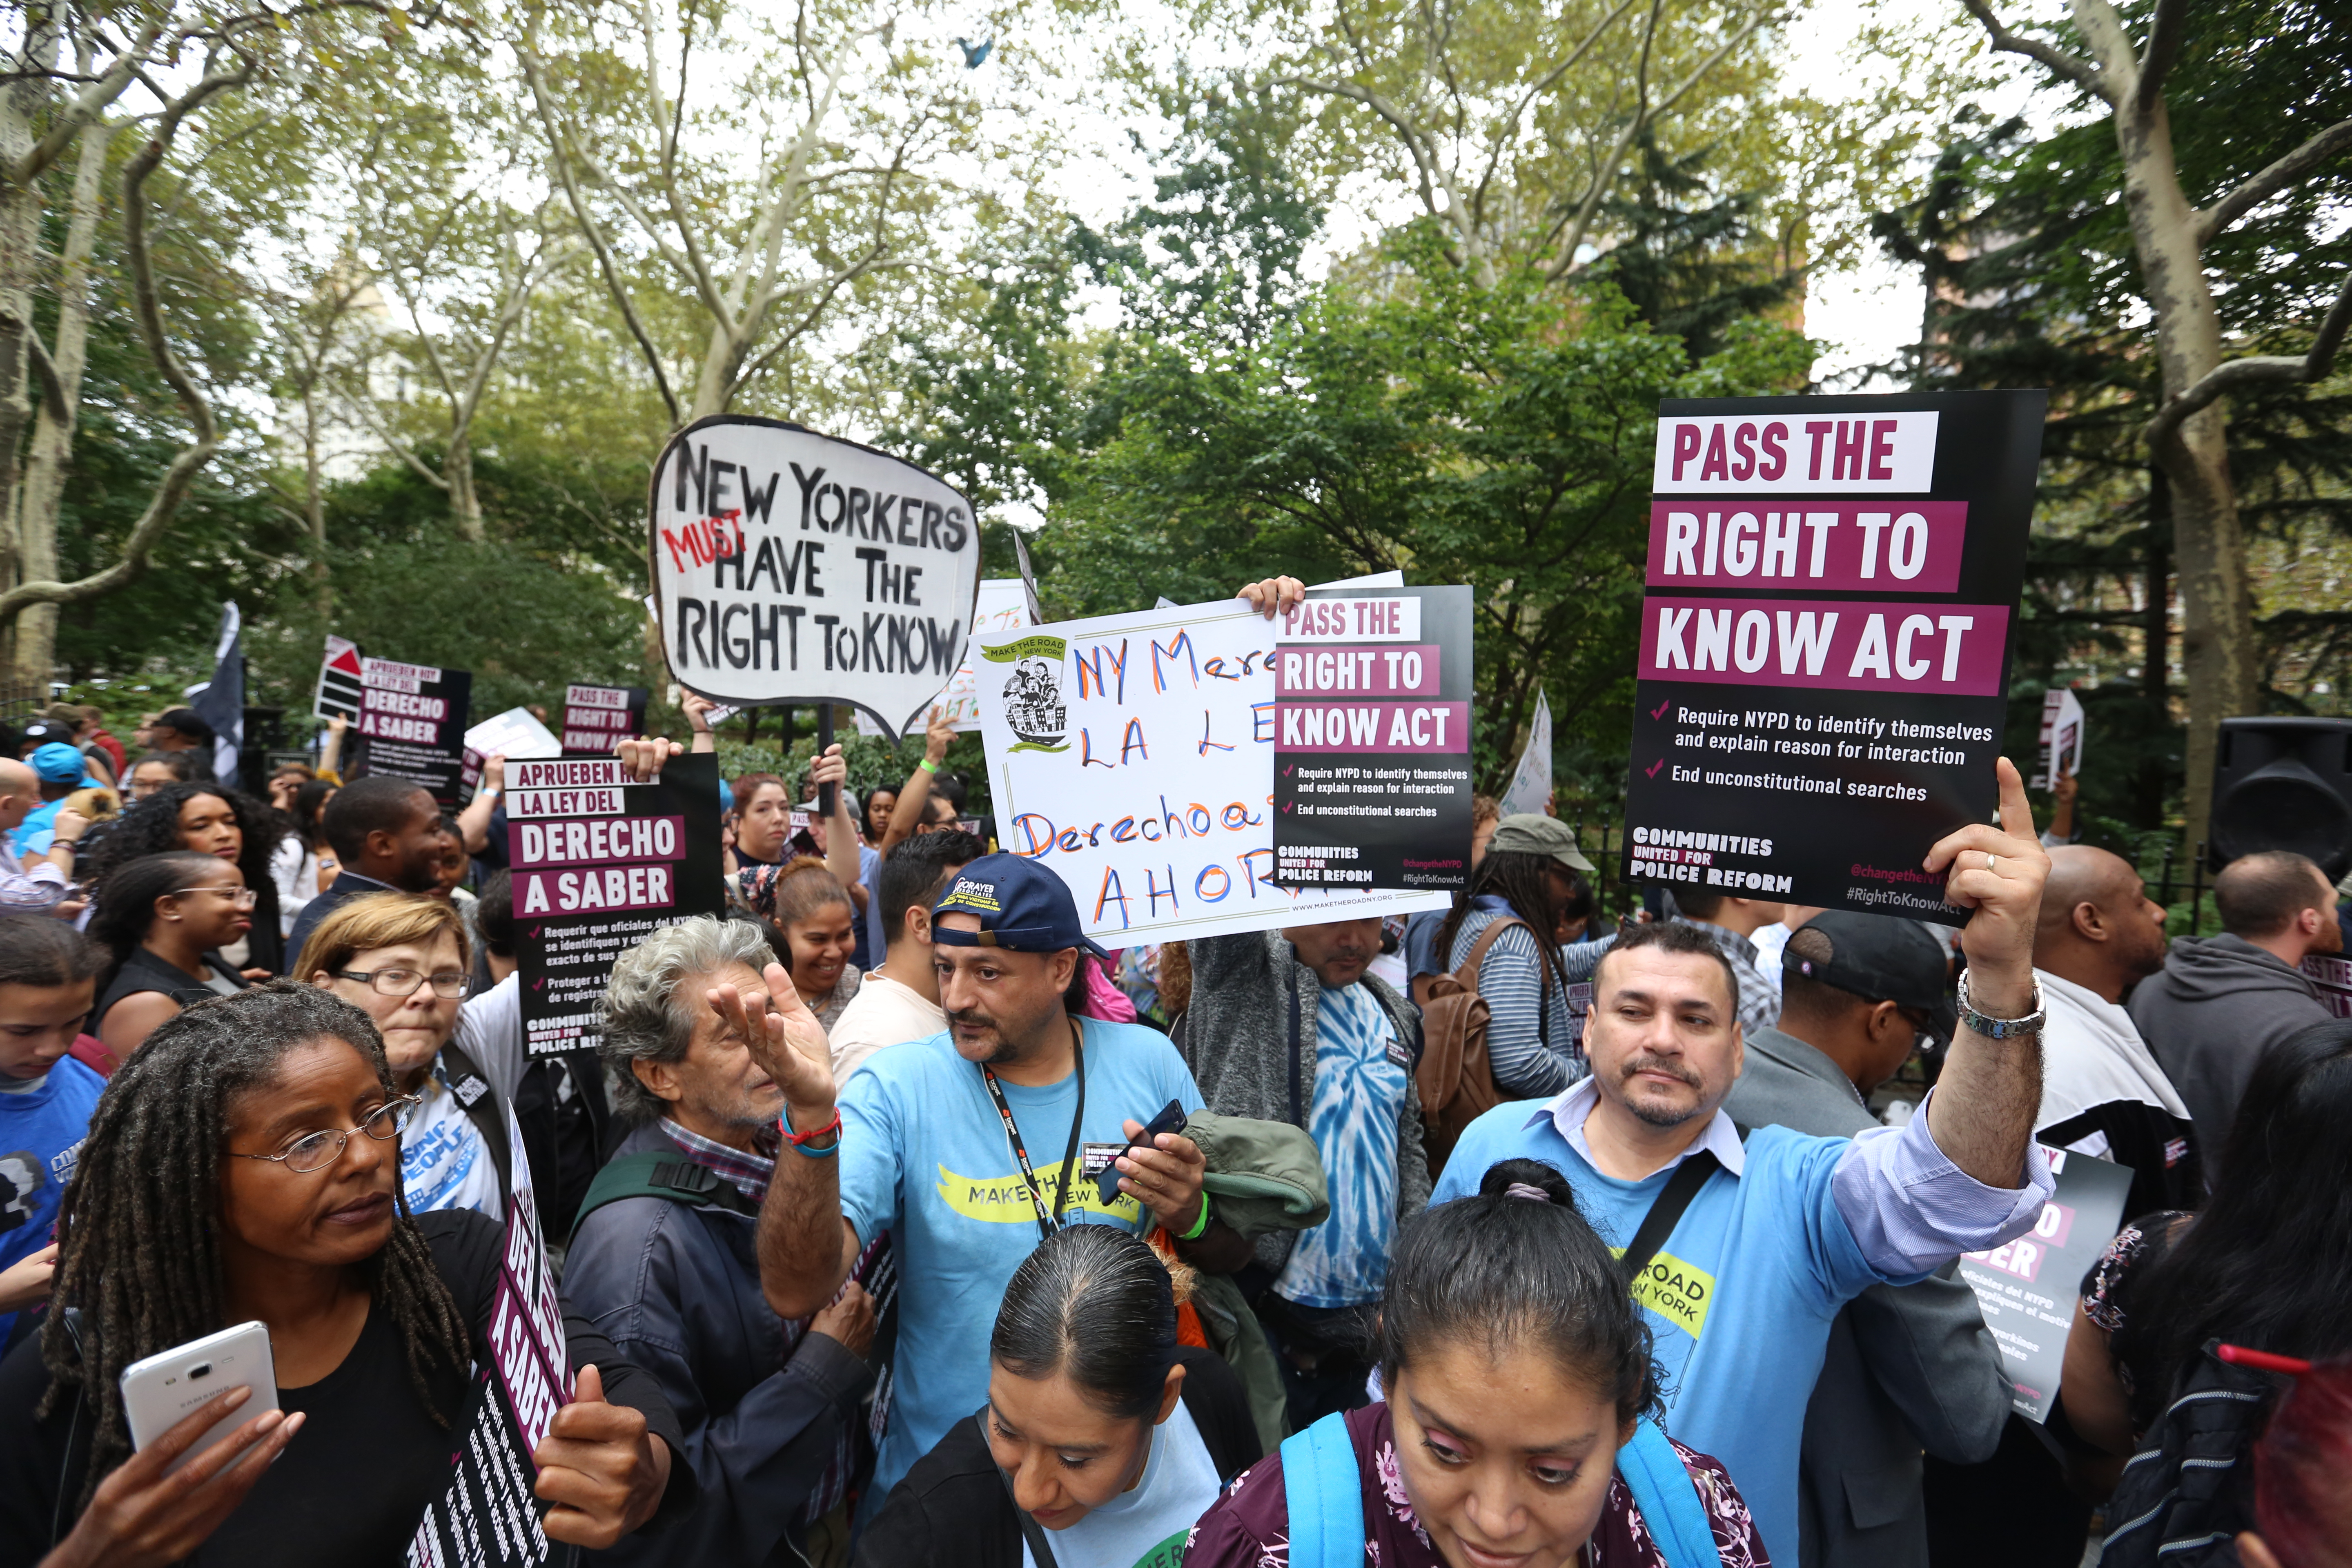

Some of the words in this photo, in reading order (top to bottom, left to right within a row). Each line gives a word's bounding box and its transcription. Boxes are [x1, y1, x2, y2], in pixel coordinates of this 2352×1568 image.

[1672, 422, 1789, 481] PASS
[1805, 420, 1897, 481] THE
[676, 439, 780, 523] NEW
[788, 463, 967, 552] YORKERS
[661, 508, 746, 573] MUST
[1663, 512, 1839, 578] RIGHT
[1856, 512, 1928, 580] TO
[714, 532, 824, 597] HAVE
[855, 547, 922, 606] THE
[1285, 603, 1346, 635] PASS
[1354, 601, 1400, 635] THE
[678, 597, 805, 671] RIGHT
[863, 612, 959, 675] KNOW
[1655, 608, 1839, 676] KNOW
[1848, 613, 1974, 682] ACT
[991, 646, 1017, 657] MAKE
[1017, 639, 1036, 650] THE
[1037, 639, 1064, 649] ROAD
[1024, 648, 1042, 656] NEW
[1043, 648, 1062, 657] YORK
[1074, 638, 1128, 705] NY
[1284, 652, 1375, 690] RIGHT
[1384, 651, 1422, 689] TO
[364, 688, 445, 719] DERECHO
[570, 688, 597, 703] PASS
[601, 691, 619, 705] THE
[362, 713, 376, 734] A
[378, 715, 437, 743] SABER
[567, 708, 608, 728] RIGHT
[610, 711, 626, 728] TO
[1283, 708, 1381, 746] KNOW
[1388, 707, 1450, 746] ACT
[1677, 707, 1738, 728] Require
[1744, 711, 1789, 730] NYPD
[1795, 715, 1811, 731] to
[1817, 715, 1885, 739] identify
[1891, 719, 1992, 741] themselves
[564, 731, 608, 750] KNOW
[1080, 716, 1148, 768] LA
[1675, 732, 1703, 748] and
[1709, 734, 1768, 754] explain
[1774, 740, 1831, 757] reason
[1837, 740, 1862, 759] for
[1867, 744, 1965, 765] interaction
[519, 763, 612, 786] APRUEBEN
[1298, 768, 1332, 780] Require
[1335, 768, 1360, 779] NYPD
[1363, 768, 1372, 779] to
[1374, 768, 1410, 781] identify
[1414, 768, 1467, 780] themselves
[1672, 765, 1699, 782] End
[1705, 771, 1841, 795] unconstitutional
[1847, 782, 1927, 802] searches
[1298, 782, 1314, 793] and
[1317, 782, 1350, 795] explain
[1353, 785, 1384, 793] reason
[1387, 783, 1400, 794] for
[1403, 783, 1454, 794] interaction
[520, 793, 544, 815] LA
[550, 792, 579, 813] LEY
[586, 791, 617, 812] DEL
[1298, 804, 1314, 815] End
[1316, 805, 1392, 816] unconstitutional
[1394, 806, 1437, 817] searches
[521, 819, 675, 863] DERECHO
[1278, 846, 1359, 859] COMMUNITIES
[1633, 826, 1773, 856] COMMUNITIES
[1279, 859, 1306, 868] UNITED
[1309, 859, 1325, 868] FOR
[1403, 859, 1462, 870] @changetheNYPD
[1633, 846, 1679, 862] UNITED
[1685, 849, 1711, 865] FOR
[955, 877, 994, 893] GORAYEB
[1278, 869, 1319, 880] POLICE
[1323, 870, 1372, 882] REFORM
[1403, 874, 1464, 885] #RightToKnowAct
[1630, 860, 1699, 883] POLICE
[1707, 869, 1793, 893] REFORM
[524, 875, 550, 913] A
[558, 868, 669, 910] SABER
[953, 888, 992, 898] ASSOCIATES
[965, 901, 1001, 911] CONSTRUCCION
[1292, 894, 1392, 911] WWW.MAKETHEROADNY.ORG
[544, 925, 587, 938] Requerir
[590, 925, 608, 938] que
[611, 920, 653, 932] oficiales
[655, 917, 669, 928] del
[545, 943, 557, 952] se
[560, 938, 619, 951] identifiquen
[622, 937, 628, 947] y
[546, 953, 580, 967] exacto
[583, 952, 595, 963] de
[598, 952, 615, 961] sus
[548, 976, 591, 989] Proteger
[548, 992, 561, 1003] de
[529, 1029, 561, 1041] UNITED
[564, 1027, 581, 1038] FOR
[529, 1038, 576, 1055] POLICE
[990, 1079, 1000, 1096] boost
[1007, 1117, 1017, 1135] boost
[1022, 1158, 1032, 1176] boost
[969, 1185, 1029, 1205] MAKE
[1037, 1200, 1045, 1219] boost
[1960, 1270, 2004, 1291] oficiales
[2005, 1285, 2022, 1298] del
[2024, 1292, 2054, 1309] NYPD
[1654, 1287, 1699, 1323] YORK
[1975, 1287, 2024, 1312] expliquen
[2025, 1307, 2038, 1317] el
[491, 1287, 510, 1357] A
[485, 1379, 503, 1431] Requerir
[500, 1427, 510, 1453] que
[507, 1448, 528, 1503] oficiales
[525, 1497, 536, 1527] del
[532, 1516, 548, 1562] NYPD
[455, 1461, 472, 1517] Proteger
[470, 1428, 484, 1469] exacto
[480, 1463, 488, 1485] de
[485, 1480, 494, 1508] sus
[491, 1502, 510, 1562] acciones
[478, 1406, 485, 1425] se
[482, 1417, 506, 1490] identifiquen
[501, 1483, 510, 1501] y
[506, 1494, 528, 1560] expliquen
[525, 1555, 535, 1568] el
[446, 1486, 454, 1508] de
[450, 1503, 466, 1561] registros
[468, 1514, 474, 1529] a
[417, 1522, 429, 1564] UNITED
[470, 1519, 480, 1549] las
[473, 1544, 482, 1561] y
